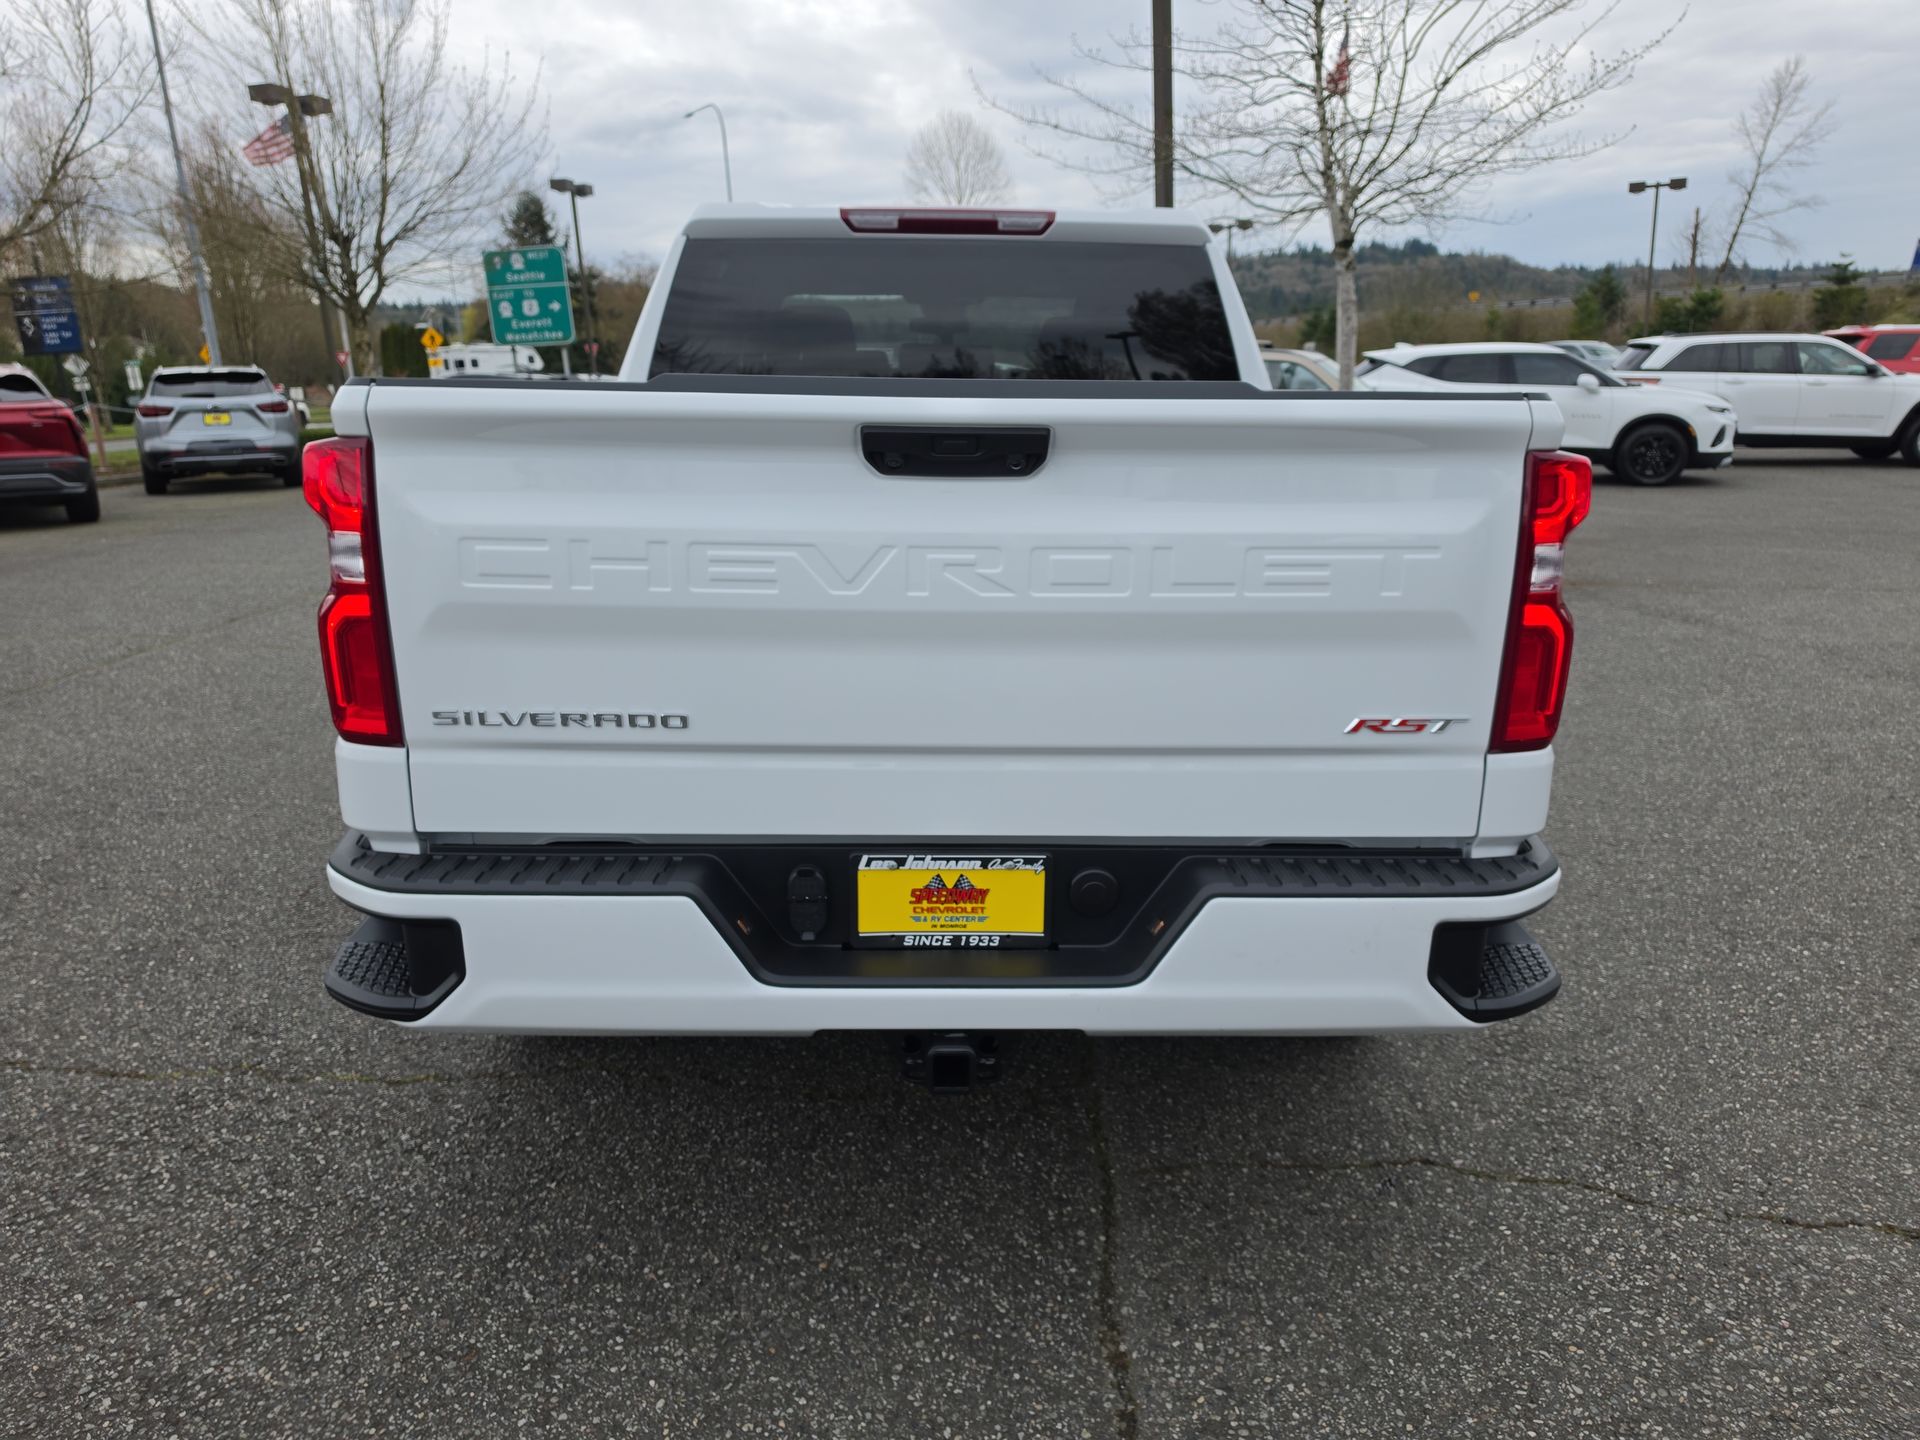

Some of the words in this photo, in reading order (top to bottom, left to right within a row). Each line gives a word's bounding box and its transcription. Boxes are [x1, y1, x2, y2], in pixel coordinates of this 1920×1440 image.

[505, 271, 546, 282] Seattle
[511, 317, 552, 329] Everett
[458, 536, 1443, 598] CHEVROLET
[431, 709, 689, 729] SILVERADO
[1343, 718, 1470, 734] RST
[899, 855, 984, 870] Johnson
[909, 887, 990, 905] SPEEDWAY
[912, 906, 986, 914] CHEVROLET
[903, 936, 954, 946] SINCE
[960, 936, 1001, 946] 1933
